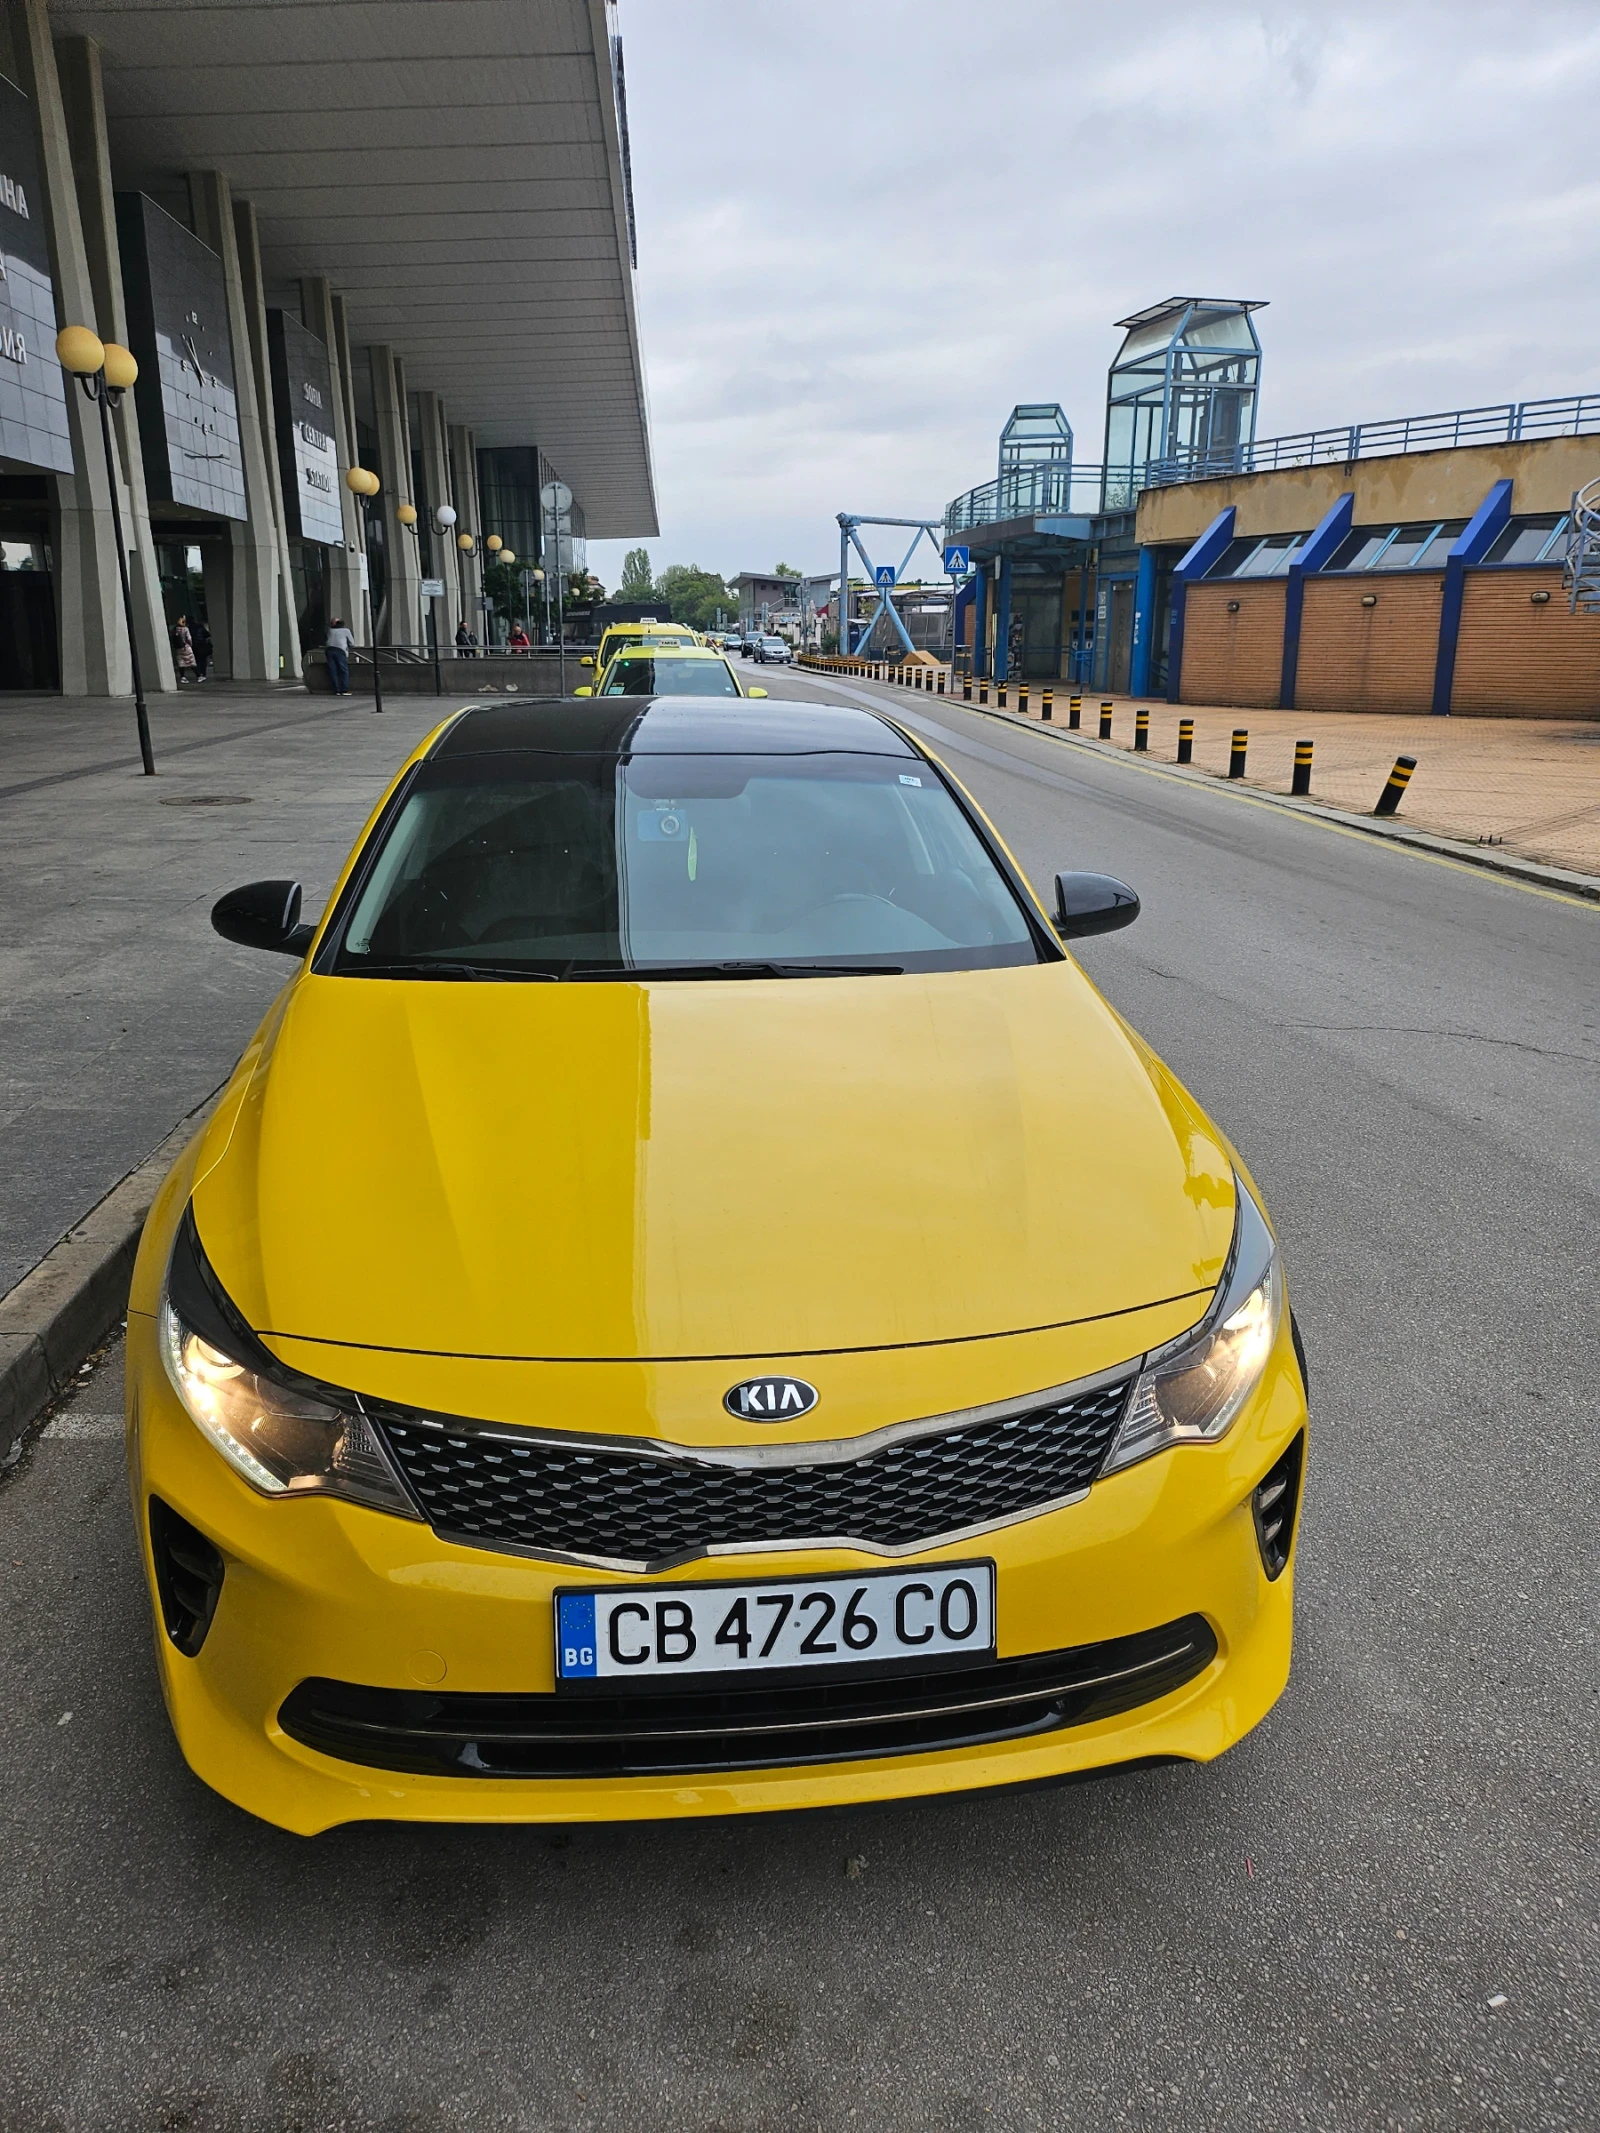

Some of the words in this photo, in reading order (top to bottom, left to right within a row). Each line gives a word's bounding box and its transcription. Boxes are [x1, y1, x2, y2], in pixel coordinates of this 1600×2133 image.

[0, 325, 28, 365] ИЯ
[303, 382, 323, 410] SOFIA
[739, 1384, 804, 1412] KIA
[608, 1600, 697, 1664] CB
[715, 1587, 878, 1659] 4726
[895, 1579, 978, 1645] CO
[565, 1648, 594, 1667] BG
